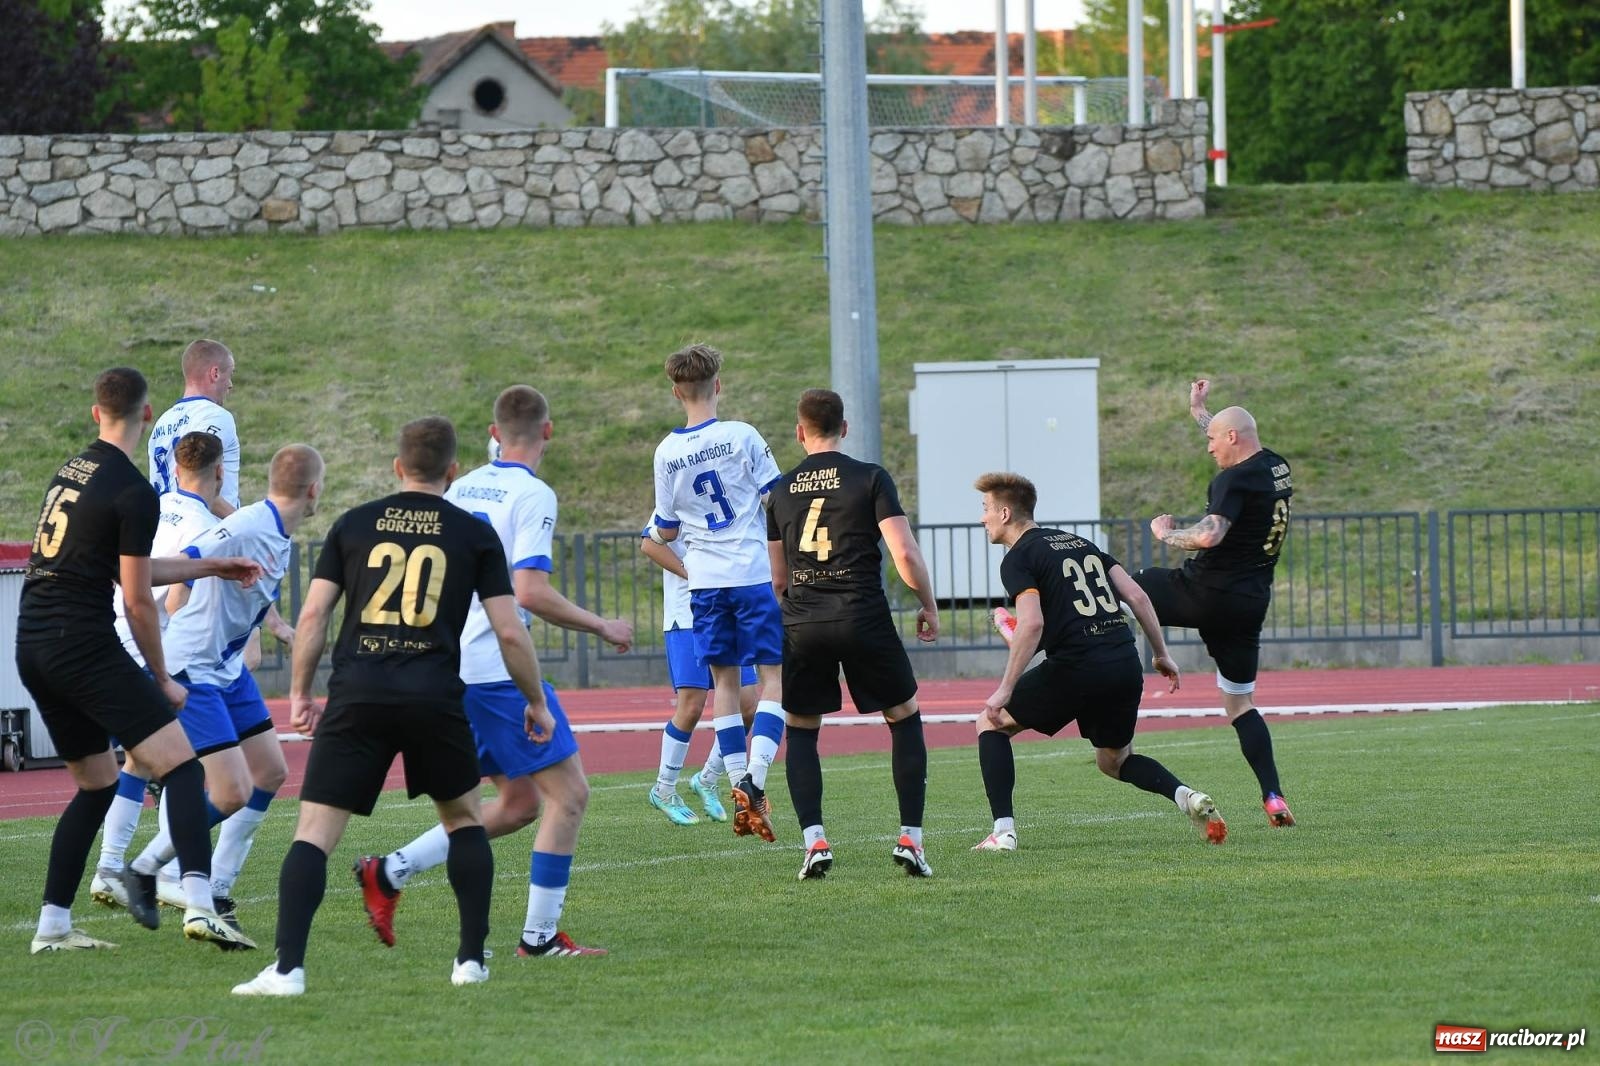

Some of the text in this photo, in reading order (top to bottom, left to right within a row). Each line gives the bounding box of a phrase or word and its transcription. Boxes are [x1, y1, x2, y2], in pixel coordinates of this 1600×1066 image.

[687, 442, 734, 467] RACIBÓRZ
[789, 477, 841, 494] GORZYCE
[796, 467, 838, 483] CZARNI
[692, 469, 737, 532] 3
[32, 484, 81, 558] 15
[375, 518, 442, 535] GORZYCE
[384, 506, 440, 522] CZARNI
[799, 497, 833, 562] 4
[1049, 539, 1088, 551] GORZYCE
[361, 541, 447, 628] 20
[1062, 554, 1119, 617] 33
